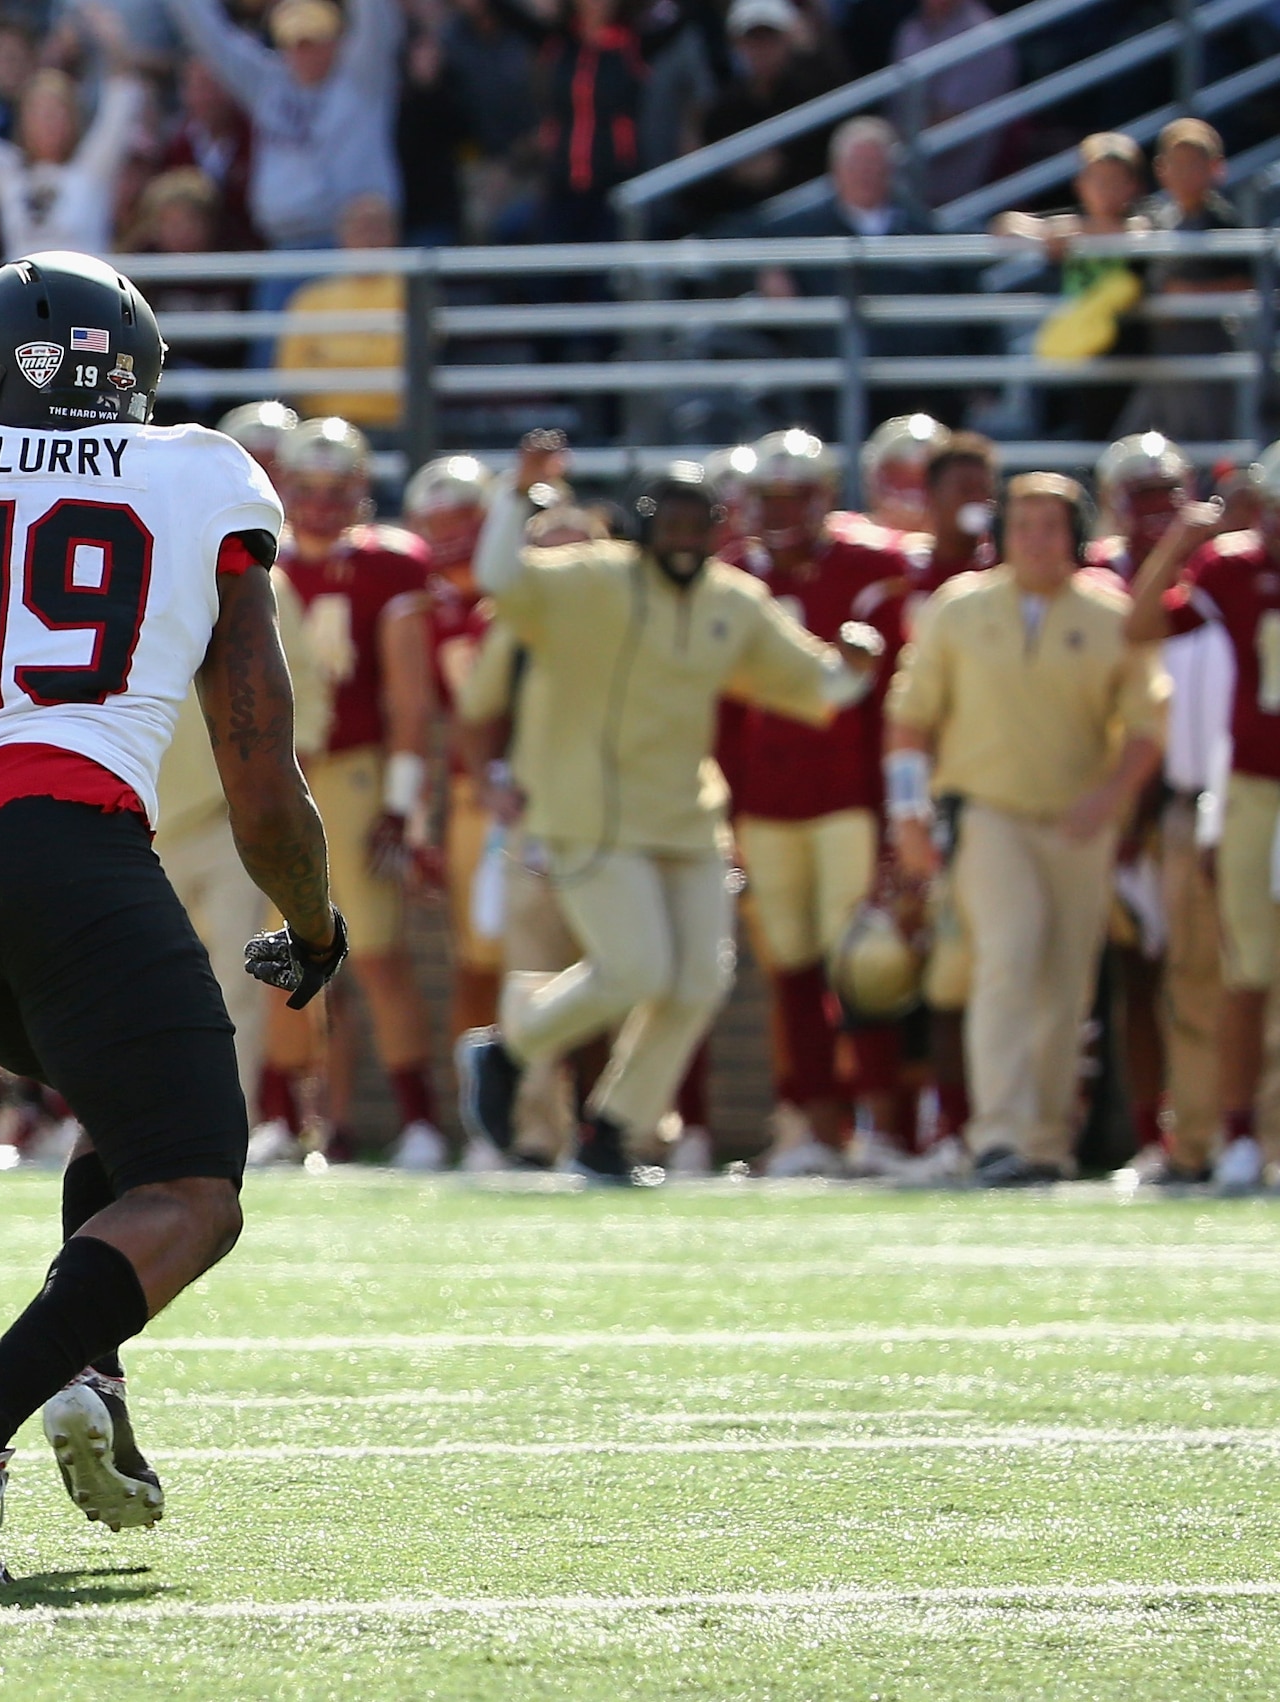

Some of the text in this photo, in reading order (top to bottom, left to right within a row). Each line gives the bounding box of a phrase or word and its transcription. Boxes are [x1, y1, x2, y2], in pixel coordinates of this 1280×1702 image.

[21, 356, 60, 370] MAC
[73, 364, 99, 388] 19
[48, 406, 119, 421] THE HARD WAY
